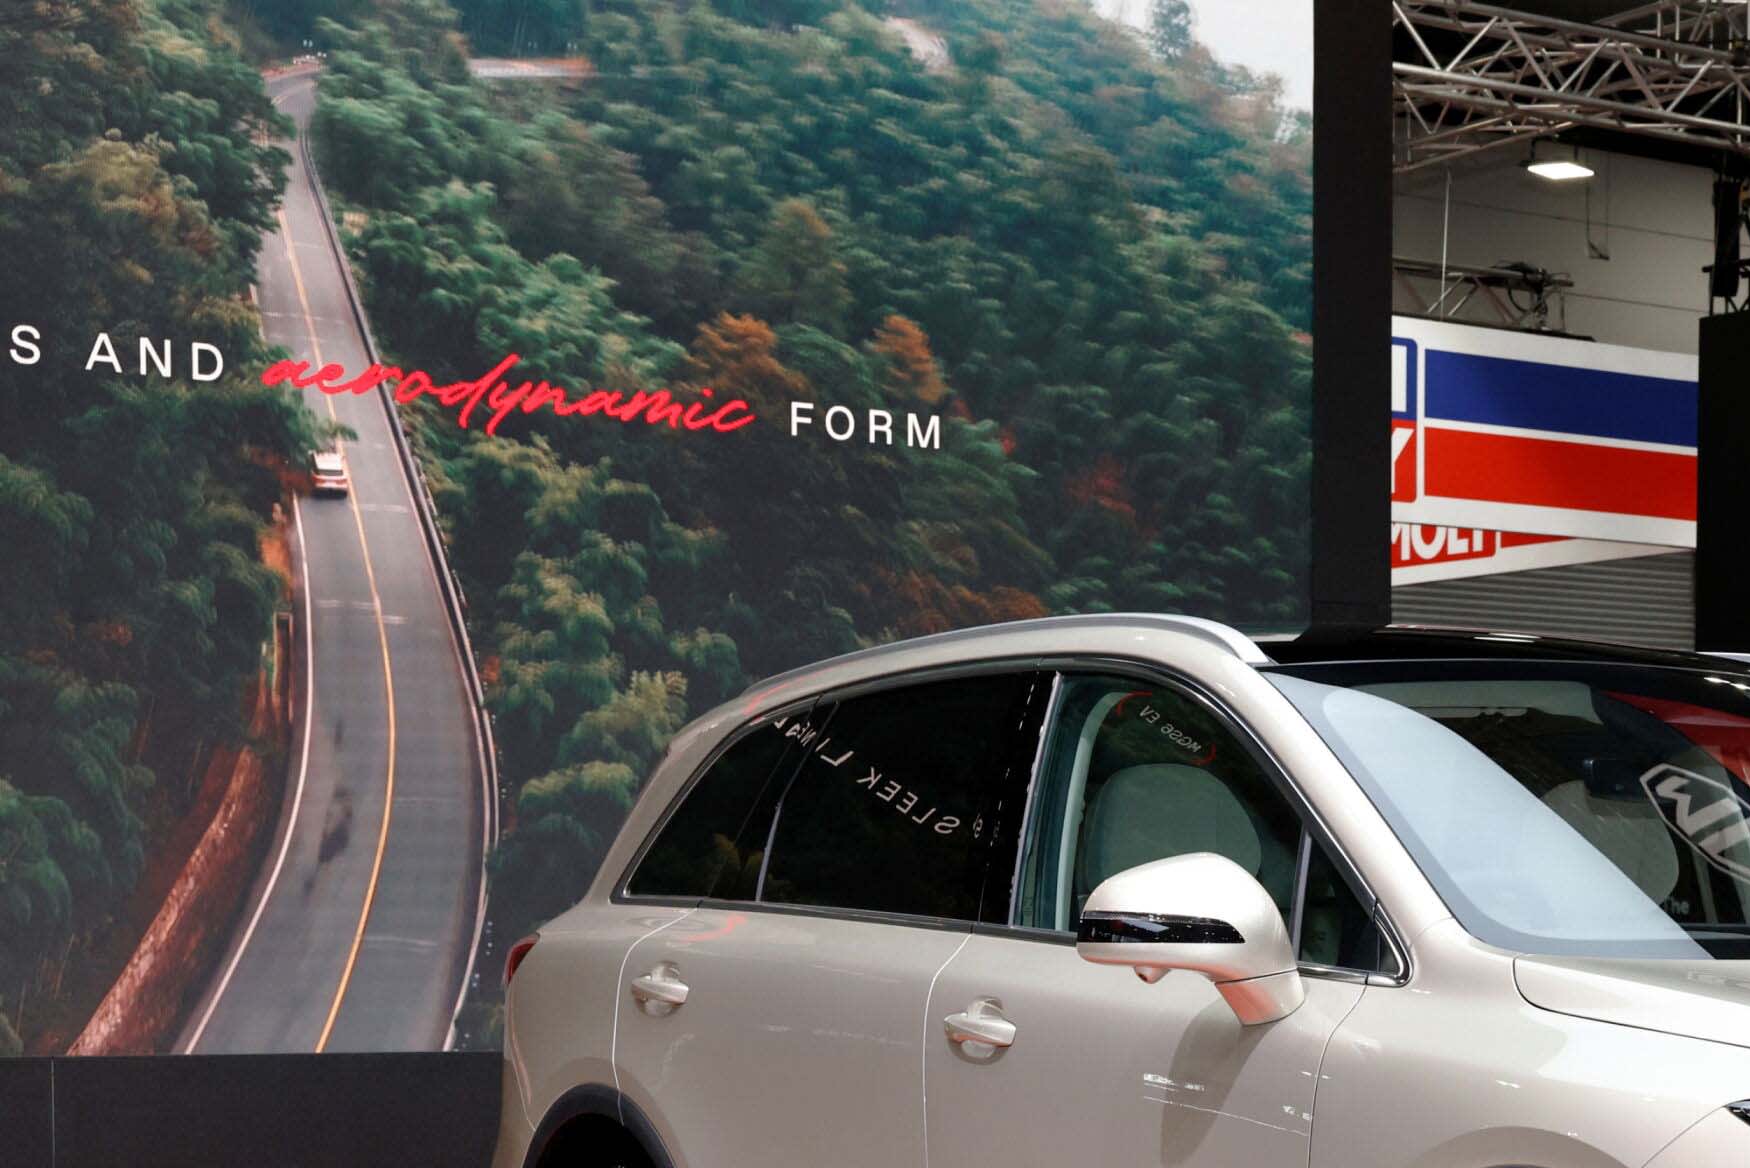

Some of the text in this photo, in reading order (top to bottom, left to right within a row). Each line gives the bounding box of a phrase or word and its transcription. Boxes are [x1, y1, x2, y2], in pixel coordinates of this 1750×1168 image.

[10, 325, 942, 450] S AND aerodynamic FORM
